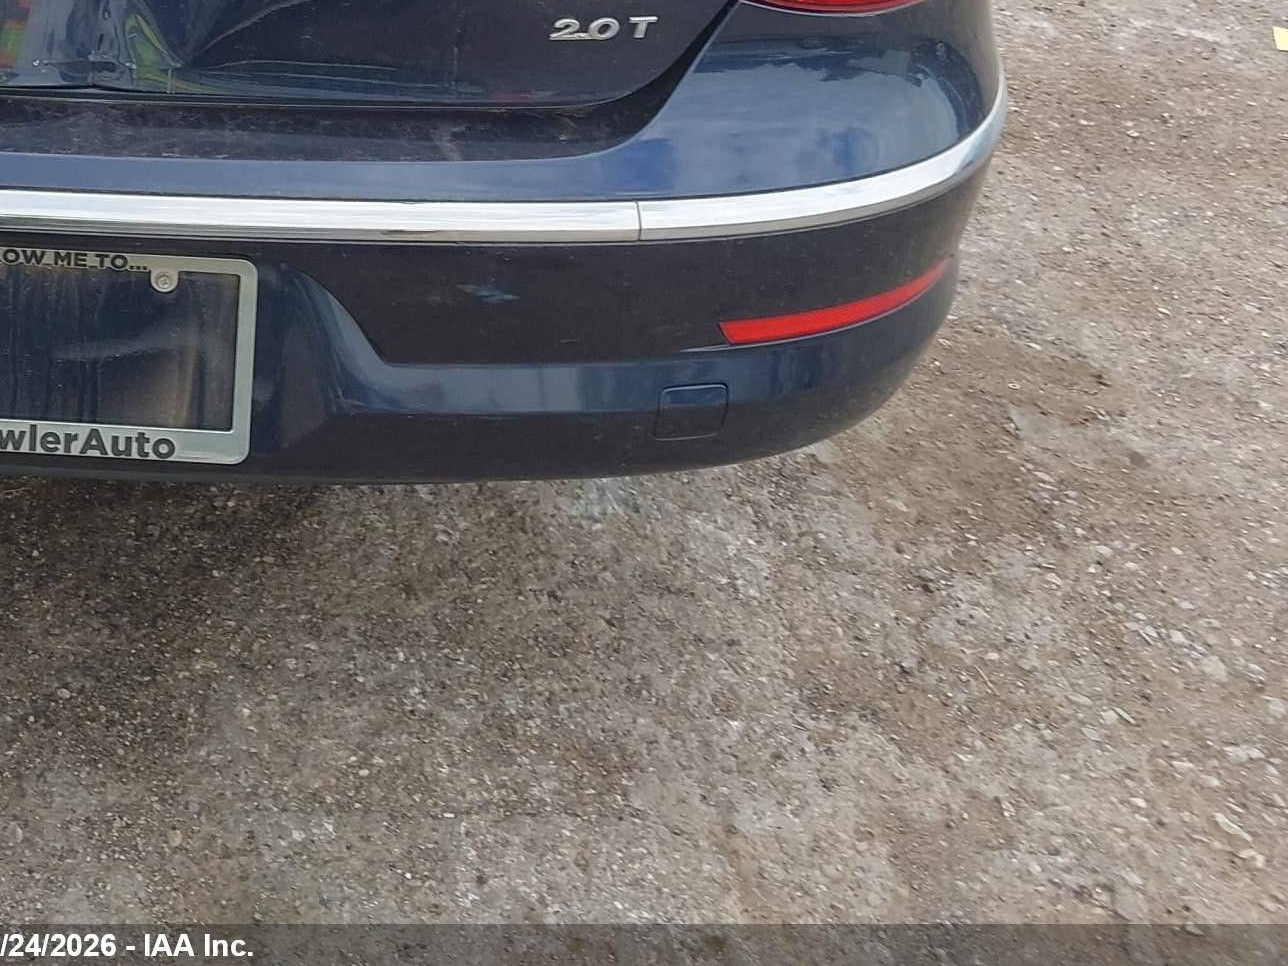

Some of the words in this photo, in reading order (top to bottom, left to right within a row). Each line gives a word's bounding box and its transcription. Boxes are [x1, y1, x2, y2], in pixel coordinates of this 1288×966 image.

[629, 16, 659, 39] T
[54, 250, 88, 268] ME
[95, 253, 148, 271] TO...
